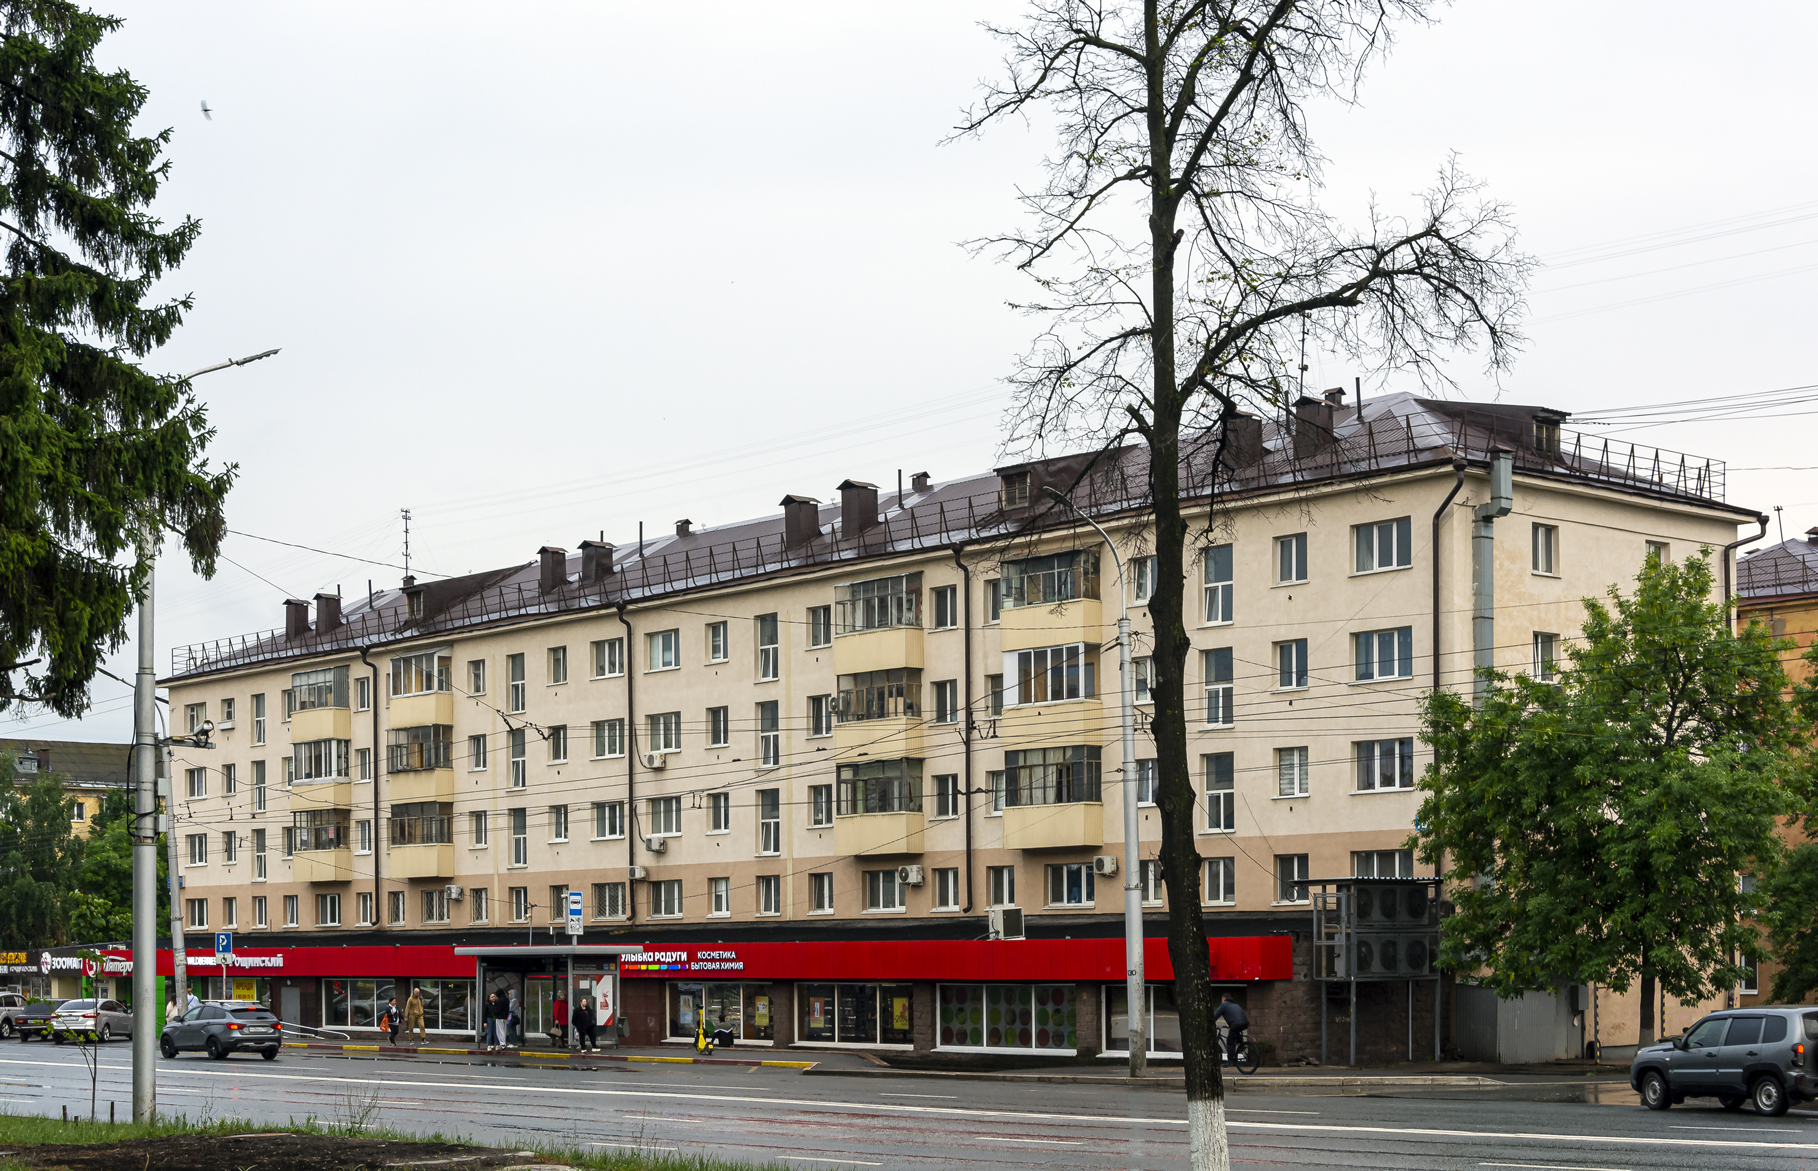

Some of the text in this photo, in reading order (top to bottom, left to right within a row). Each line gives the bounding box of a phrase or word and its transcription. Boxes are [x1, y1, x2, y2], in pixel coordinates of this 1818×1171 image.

[697, 951, 736, 959] КОСМЕТИКА
[690, 961, 744, 970] БЫТОВАЯ ХИМИЯ
